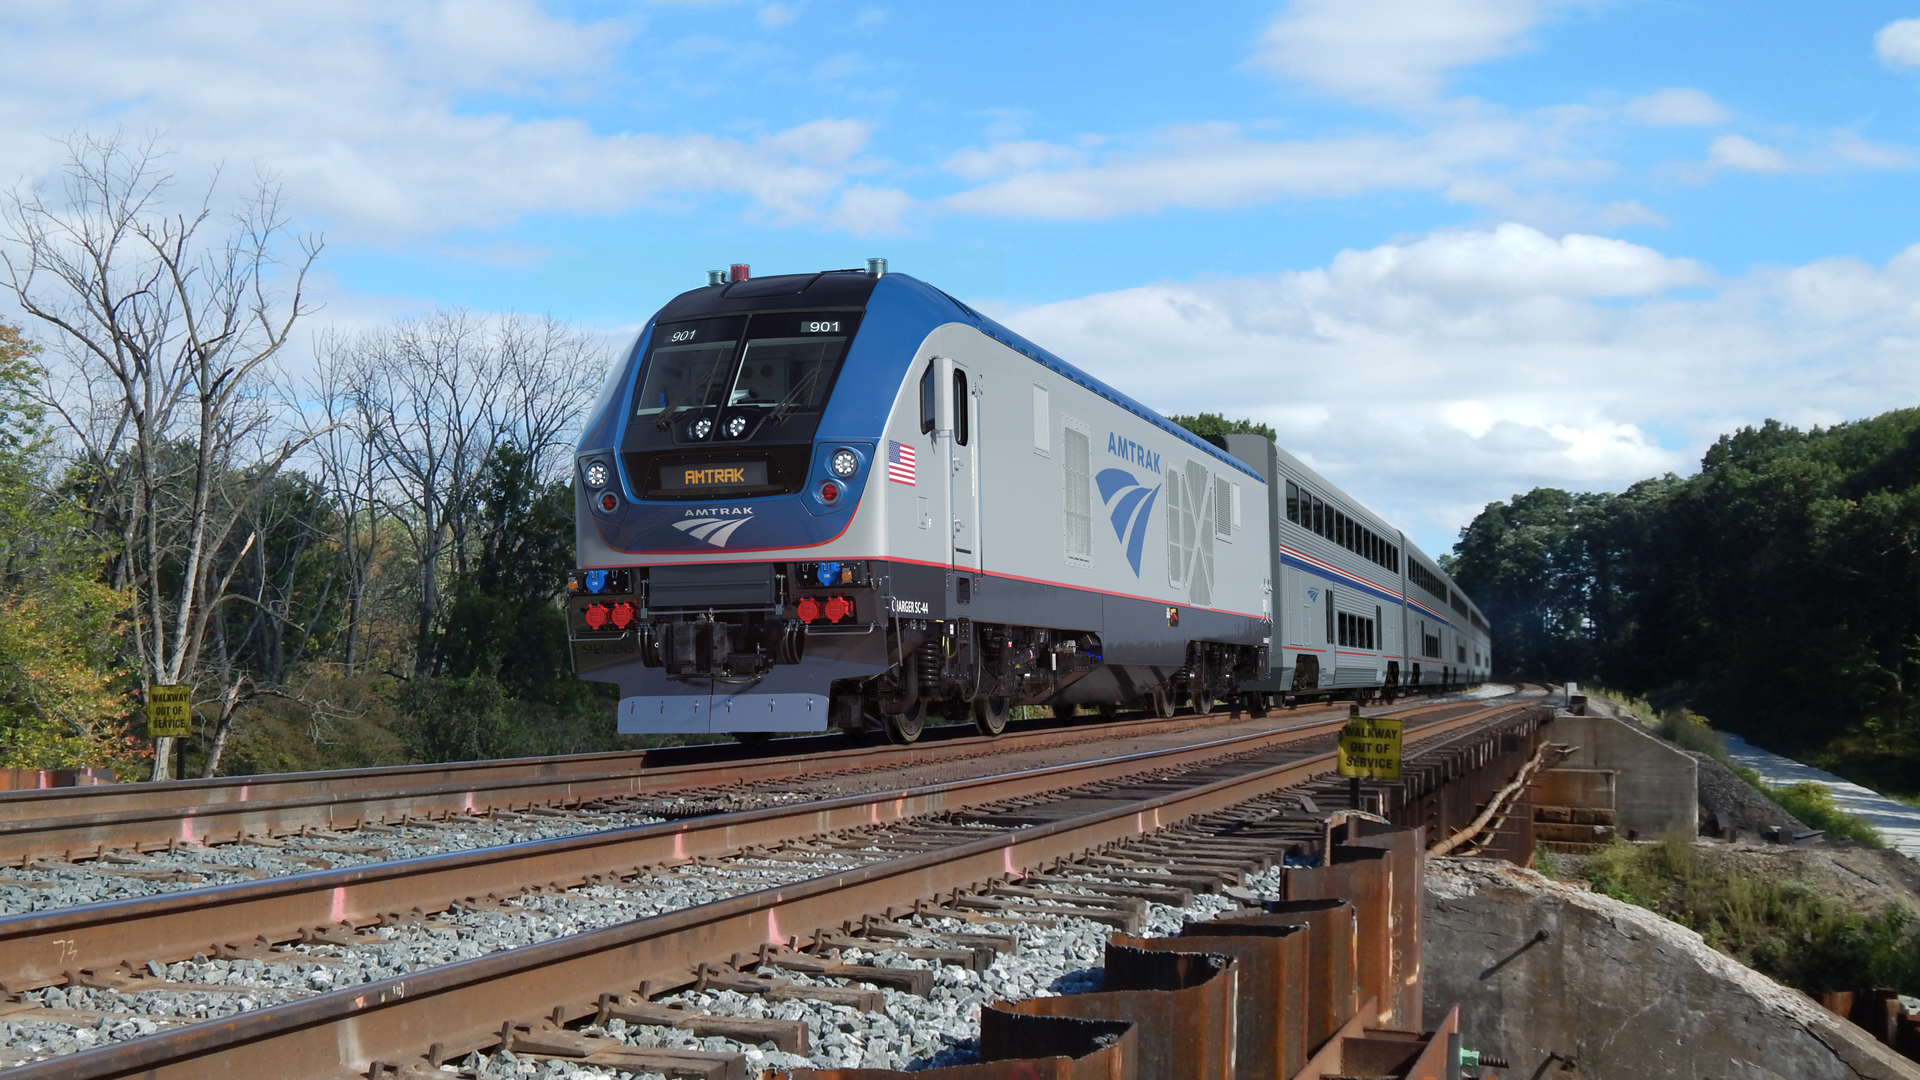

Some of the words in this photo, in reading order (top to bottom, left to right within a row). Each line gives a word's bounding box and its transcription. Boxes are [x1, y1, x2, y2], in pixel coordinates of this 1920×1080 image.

[809, 321, 839, 332] 901
[671, 329, 697, 342] 901
[1107, 431, 1161, 475] AMTRAK
[684, 467, 745, 485] AMTRAK
[684, 506, 754, 517] AMTRAK
[582, 643, 635, 655] SIEMENS
[152, 693, 188, 702] WALKWAY
[155, 706, 170, 716] OUT
[172, 706, 183, 716] OF
[153, 718, 186, 729] SERVICE
[1344, 726, 1398, 740] WALKWAY
[1350, 741, 1372, 753] OUT
[1375, 743, 1390, 754] OF
[1346, 755, 1393, 770] SERVICE
